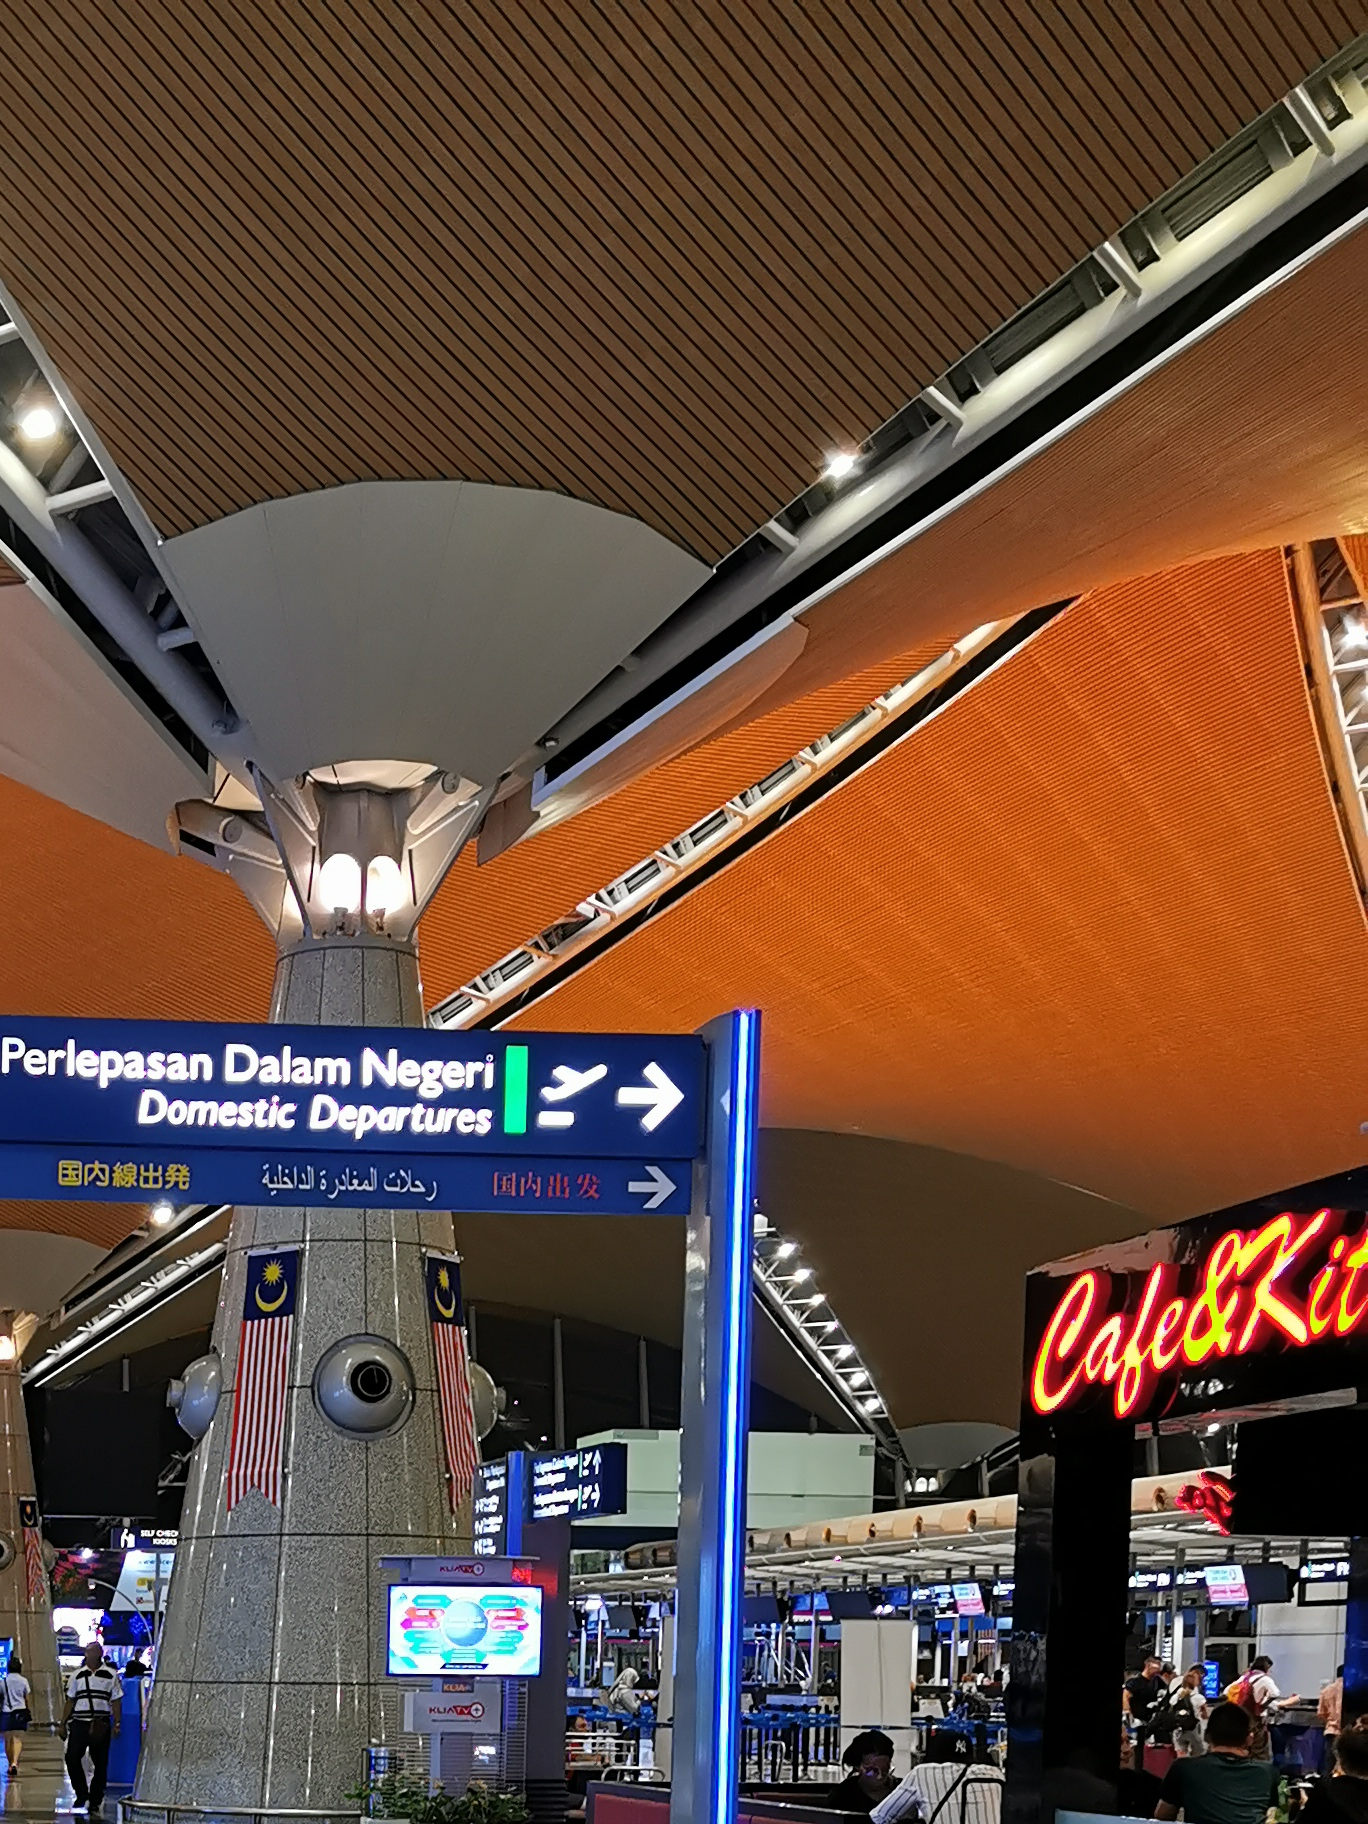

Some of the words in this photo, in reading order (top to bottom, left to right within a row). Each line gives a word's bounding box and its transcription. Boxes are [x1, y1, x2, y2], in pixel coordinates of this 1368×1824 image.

[1, 1036, 213, 1088] Perlepasan
[225, 1043, 351, 1087] Dalam
[362, 1047, 494, 1099] Negeri
[138, 1089, 297, 1129] Domestic
[309, 1094, 493, 1140] Departures
[58, 1159, 191, 1190] 国内線出発
[261, 1163, 315, 1196] الداخلية
[318, 1166, 378, 1200] المغادرة
[383, 1168, 438, 1201] رحلات
[493, 1171, 601, 1199] 国内出发
